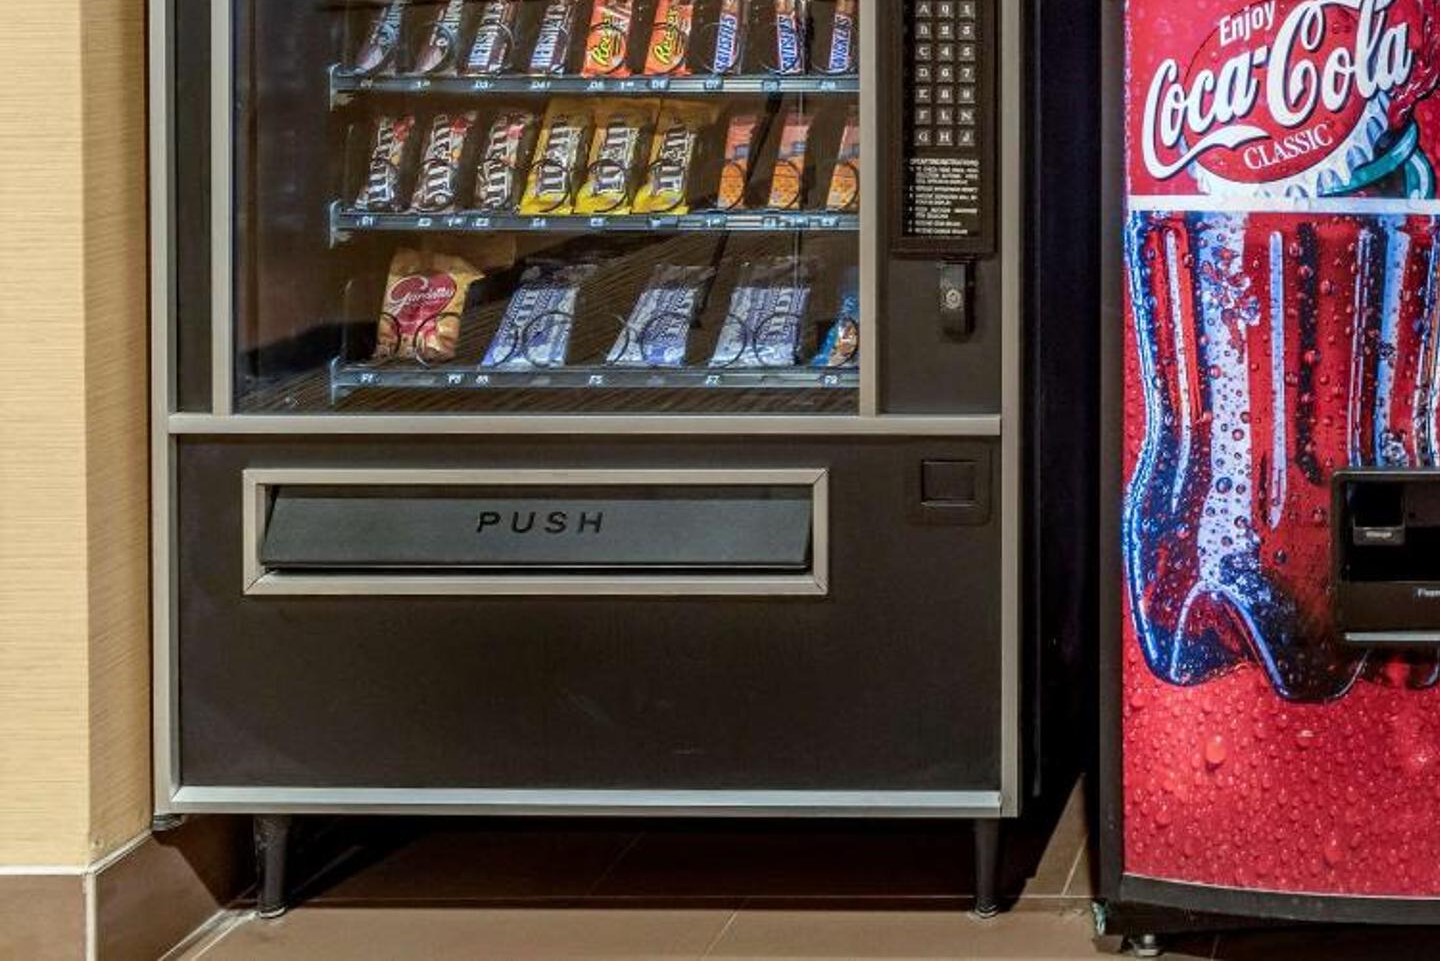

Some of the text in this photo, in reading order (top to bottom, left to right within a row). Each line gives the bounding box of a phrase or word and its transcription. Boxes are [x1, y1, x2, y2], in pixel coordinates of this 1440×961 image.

[1218, 0, 1276, 47] Enjoy
[918, 46, 929, 57] C
[940, 46, 950, 57] 4
[918, 67, 929, 78] D
[962, 67, 971, 79] 7
[1243, 123, 1332, 170] CLASSIC
[476, 511, 603, 534] PUSH
